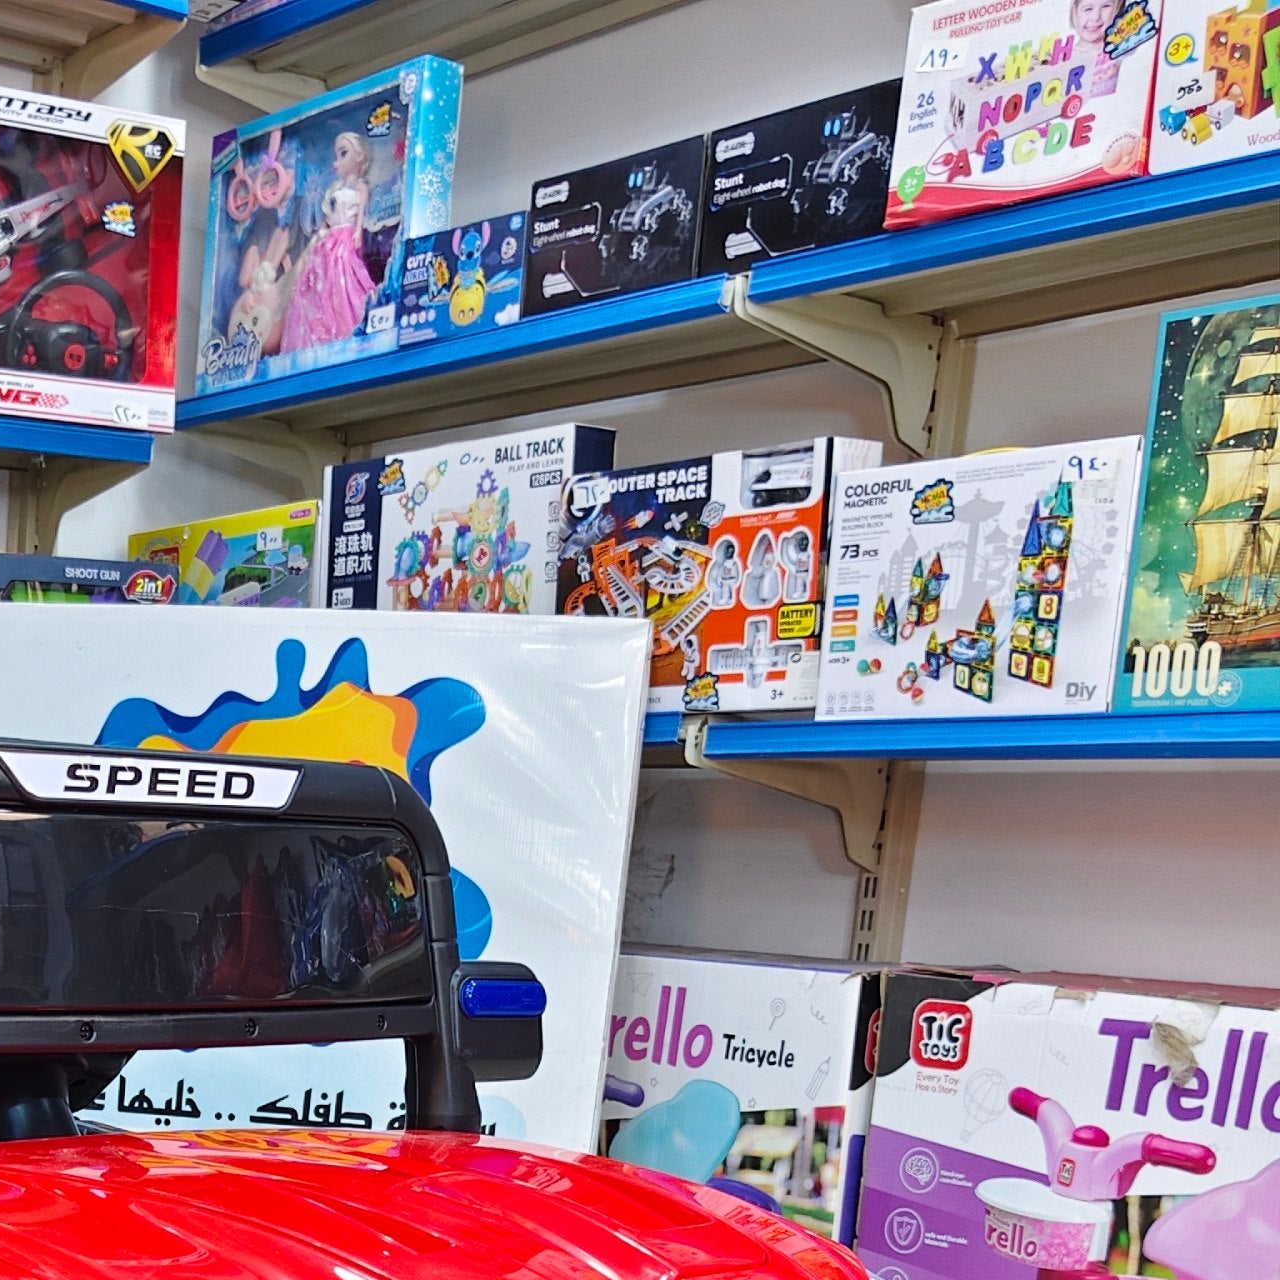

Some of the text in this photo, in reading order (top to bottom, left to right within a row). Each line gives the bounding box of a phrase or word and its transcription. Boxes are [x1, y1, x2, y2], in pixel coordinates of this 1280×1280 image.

[932, 0, 1017, 31] LETTER WOODEN
[948, 11, 1023, 39] PULLING TOY CAR
[1168, 42, 1192, 58] 3+
[916, 90, 936, 109] 26
[909, 107, 938, 122] English
[907, 121, 935, 134] Letters
[714, 172, 744, 191] Stunt
[752, 181, 772, 194] robot
[772, 178, 787, 189] dog
[534, 218, 560, 235] Stunt
[494, 436, 566, 465] BALL TRACK
[507, 457, 565, 474] PLAY AND LEARN
[531, 471, 562, 488] 126PCS
[608, 464, 709, 495] OUTER SPACE
[655, 481, 708, 504] TRACK
[844, 478, 914, 499] COLORFUL
[843, 496, 889, 510] MAGNETIC
[839, 544, 879, 561] 73 PCS
[64, 566, 121, 582] SHOOT GUN
[332, 553, 373, 578] 道积木
[134, 577, 164, 594] 2in1
[779, 607, 814, 620] BATTERY
[1131, 640, 1221, 699] 1000
[770, 689, 785, 701] 3+
[1064, 681, 1098, 701] Diy
[63, 762, 256, 801] SPEED
[608, 984, 795, 1070] rello Tricycle
[921, 1042, 959, 1060] TOYS
[916, 1071, 959, 1086] Every Toy
[915, 1082, 930, 1093] Has
[937, 1085, 958, 1098] Story
[117, 1075, 201, 1127] خليها
[249, 1089, 373, 1130] طفلك
